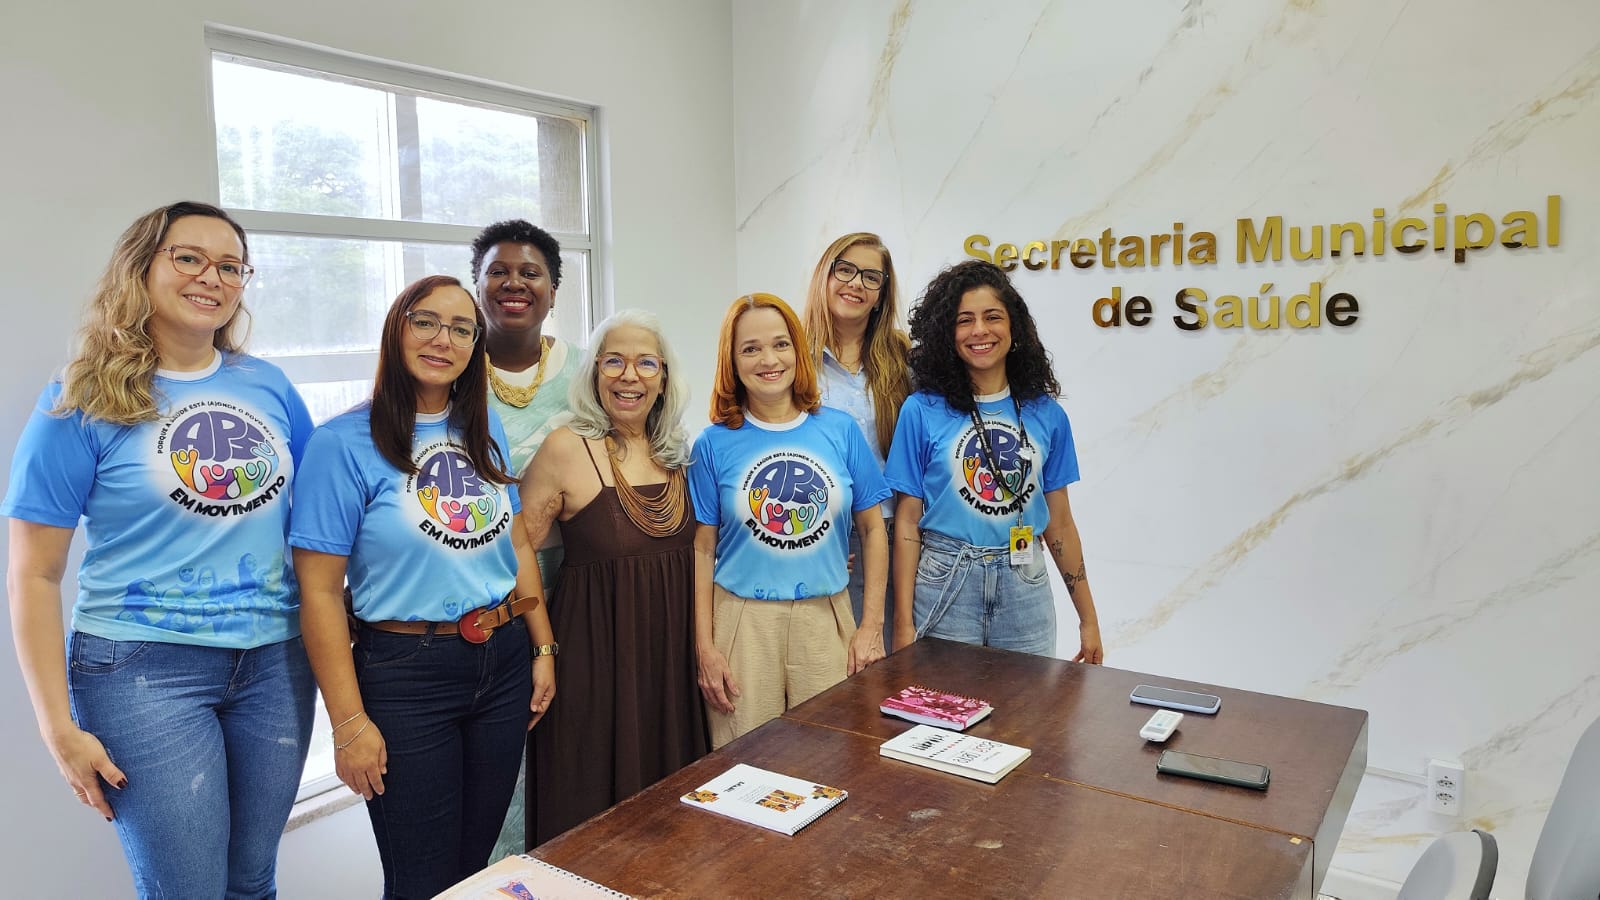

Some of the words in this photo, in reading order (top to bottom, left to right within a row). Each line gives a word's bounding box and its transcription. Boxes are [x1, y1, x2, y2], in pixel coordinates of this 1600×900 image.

[962, 222, 1217, 273] Secretaria
[1236, 194, 1562, 264] Municipal
[1092, 287, 1151, 327] de
[1174, 282, 1360, 332] Saúde
[157, 428, 168, 454] PORQUE
[189, 400, 206, 410] ESTÁ
[244, 412, 263, 427] POVO
[170, 487, 195, 510] EM
[194, 476, 286, 517] MOVIMENTO
[958, 486, 976, 506] EM
[974, 484, 1036, 516] MOVIMENTO
[418, 519, 442, 541] EM
[442, 512, 510, 550] MOVIMENTO
[744, 518, 760, 537] EM
[758, 520, 830, 550] MOVIMENTO
